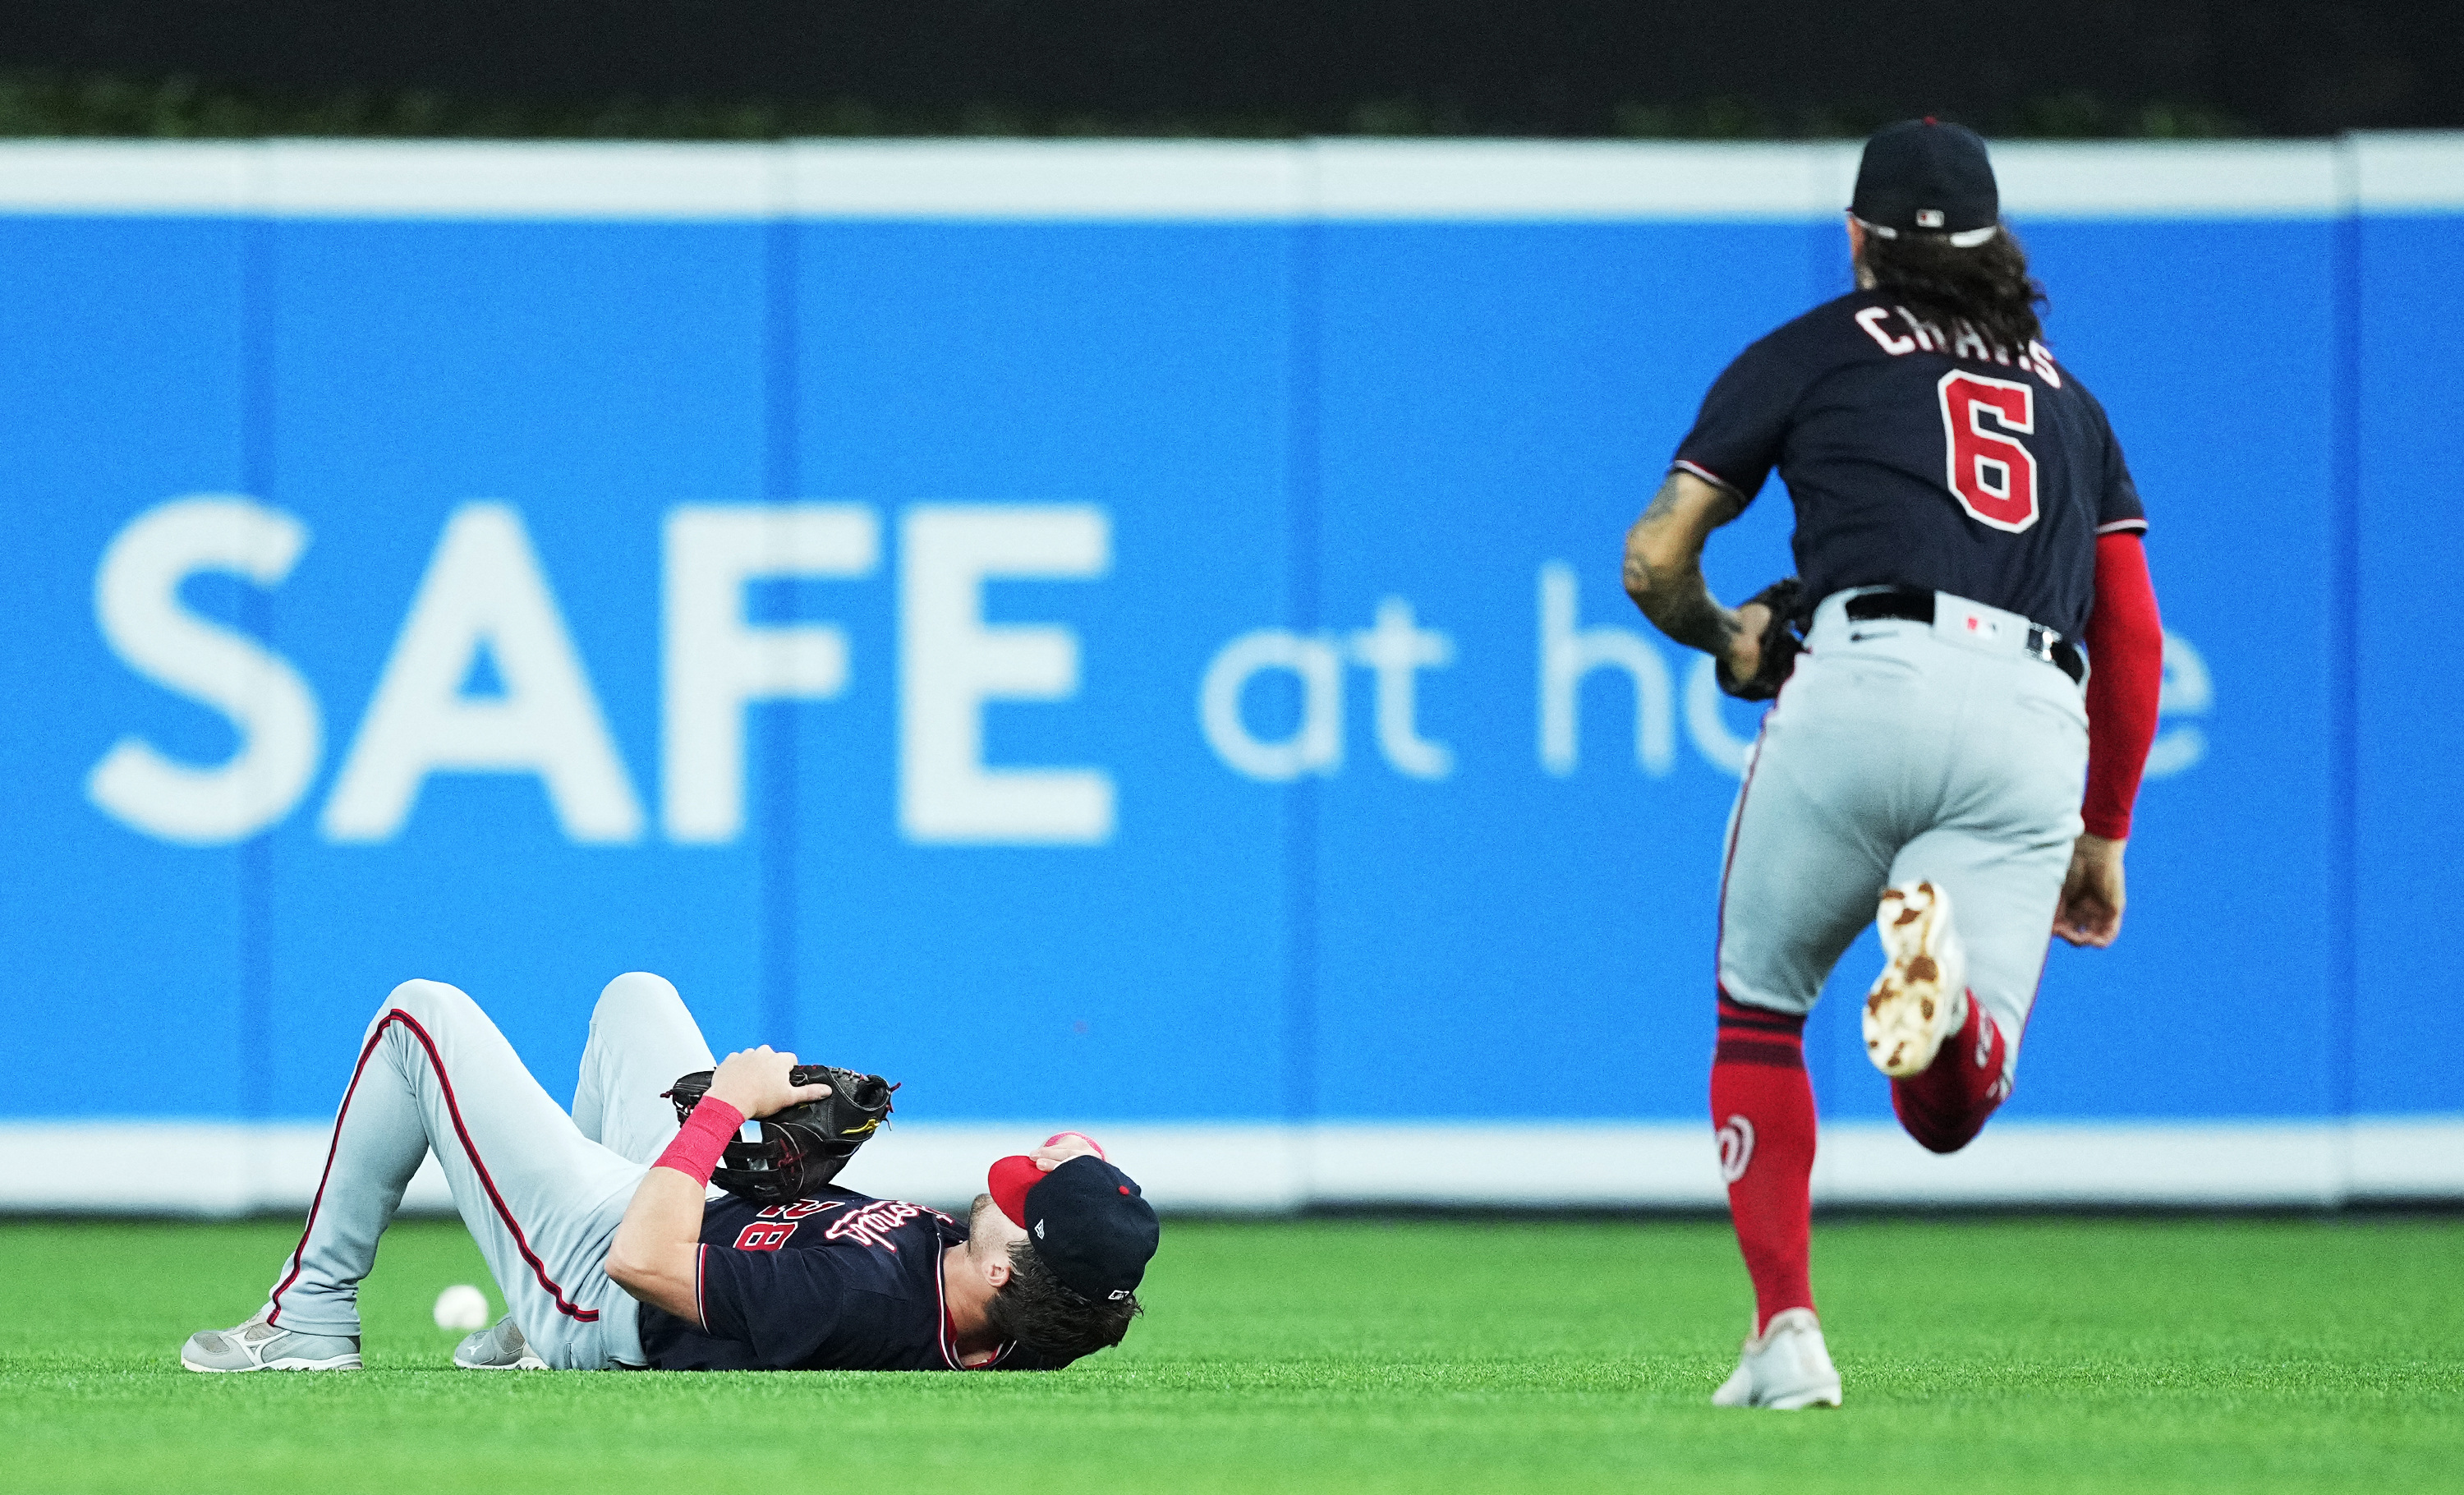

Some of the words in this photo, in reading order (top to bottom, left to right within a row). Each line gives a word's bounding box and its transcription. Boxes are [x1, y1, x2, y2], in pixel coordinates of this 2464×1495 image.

[1938, 368, 2039, 534] 6
[86, 494, 1116, 844] SAFE
[1198, 596, 1455, 780] at
[1538, 561, 2213, 779] he
